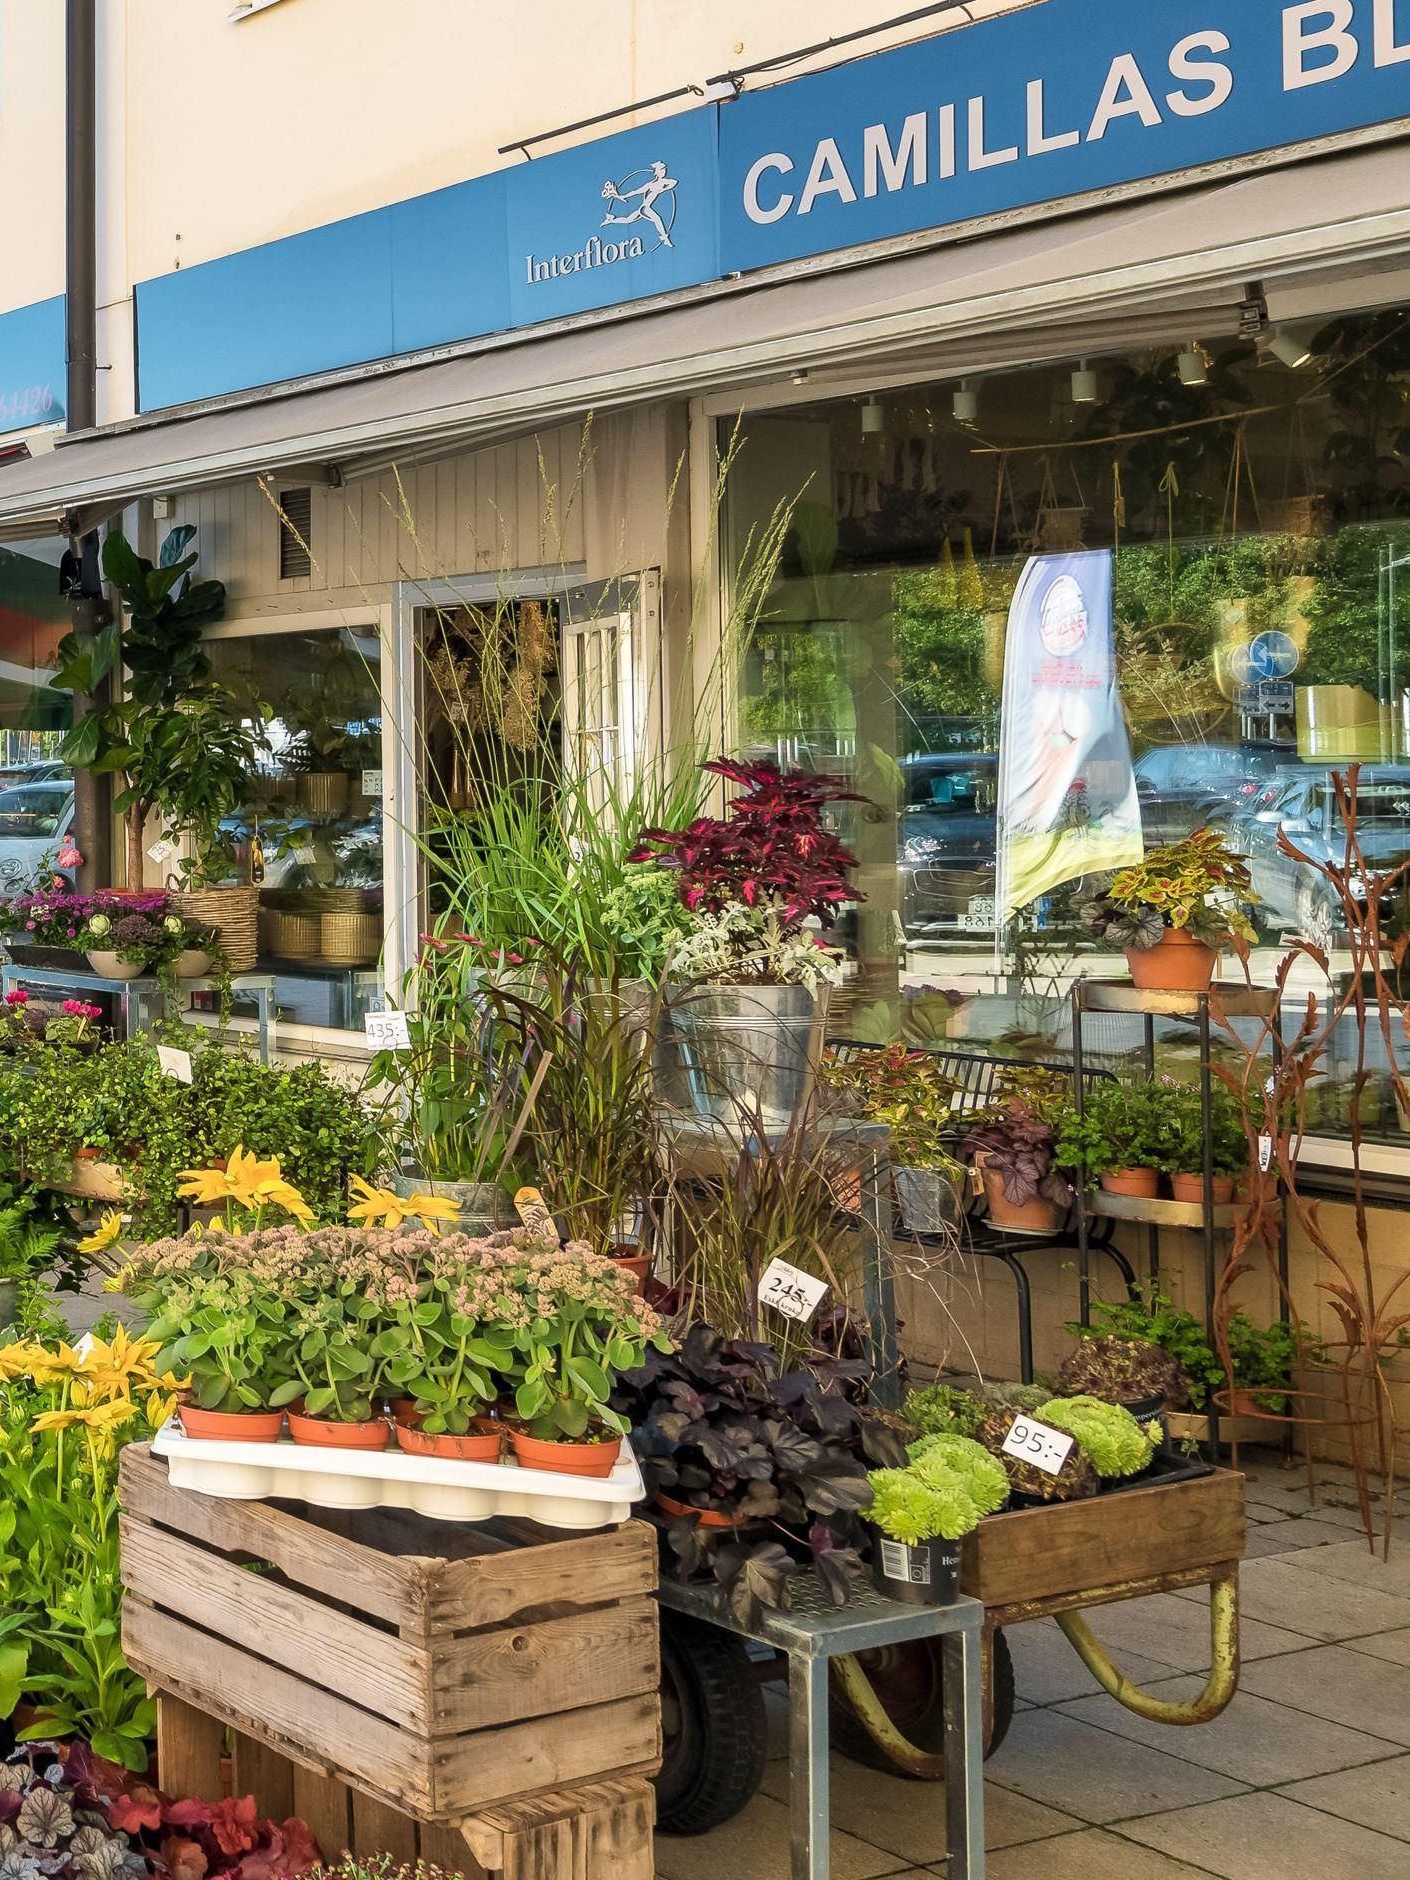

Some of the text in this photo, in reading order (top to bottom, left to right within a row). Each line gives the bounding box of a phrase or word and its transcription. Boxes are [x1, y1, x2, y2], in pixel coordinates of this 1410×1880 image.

[742, 30, 1235, 226] CAMILLAS
[526, 235, 646, 285] Interflora
[367, 1023, 406, 1038] 435:-
[1010, 1425, 1063, 1458] 95:-
